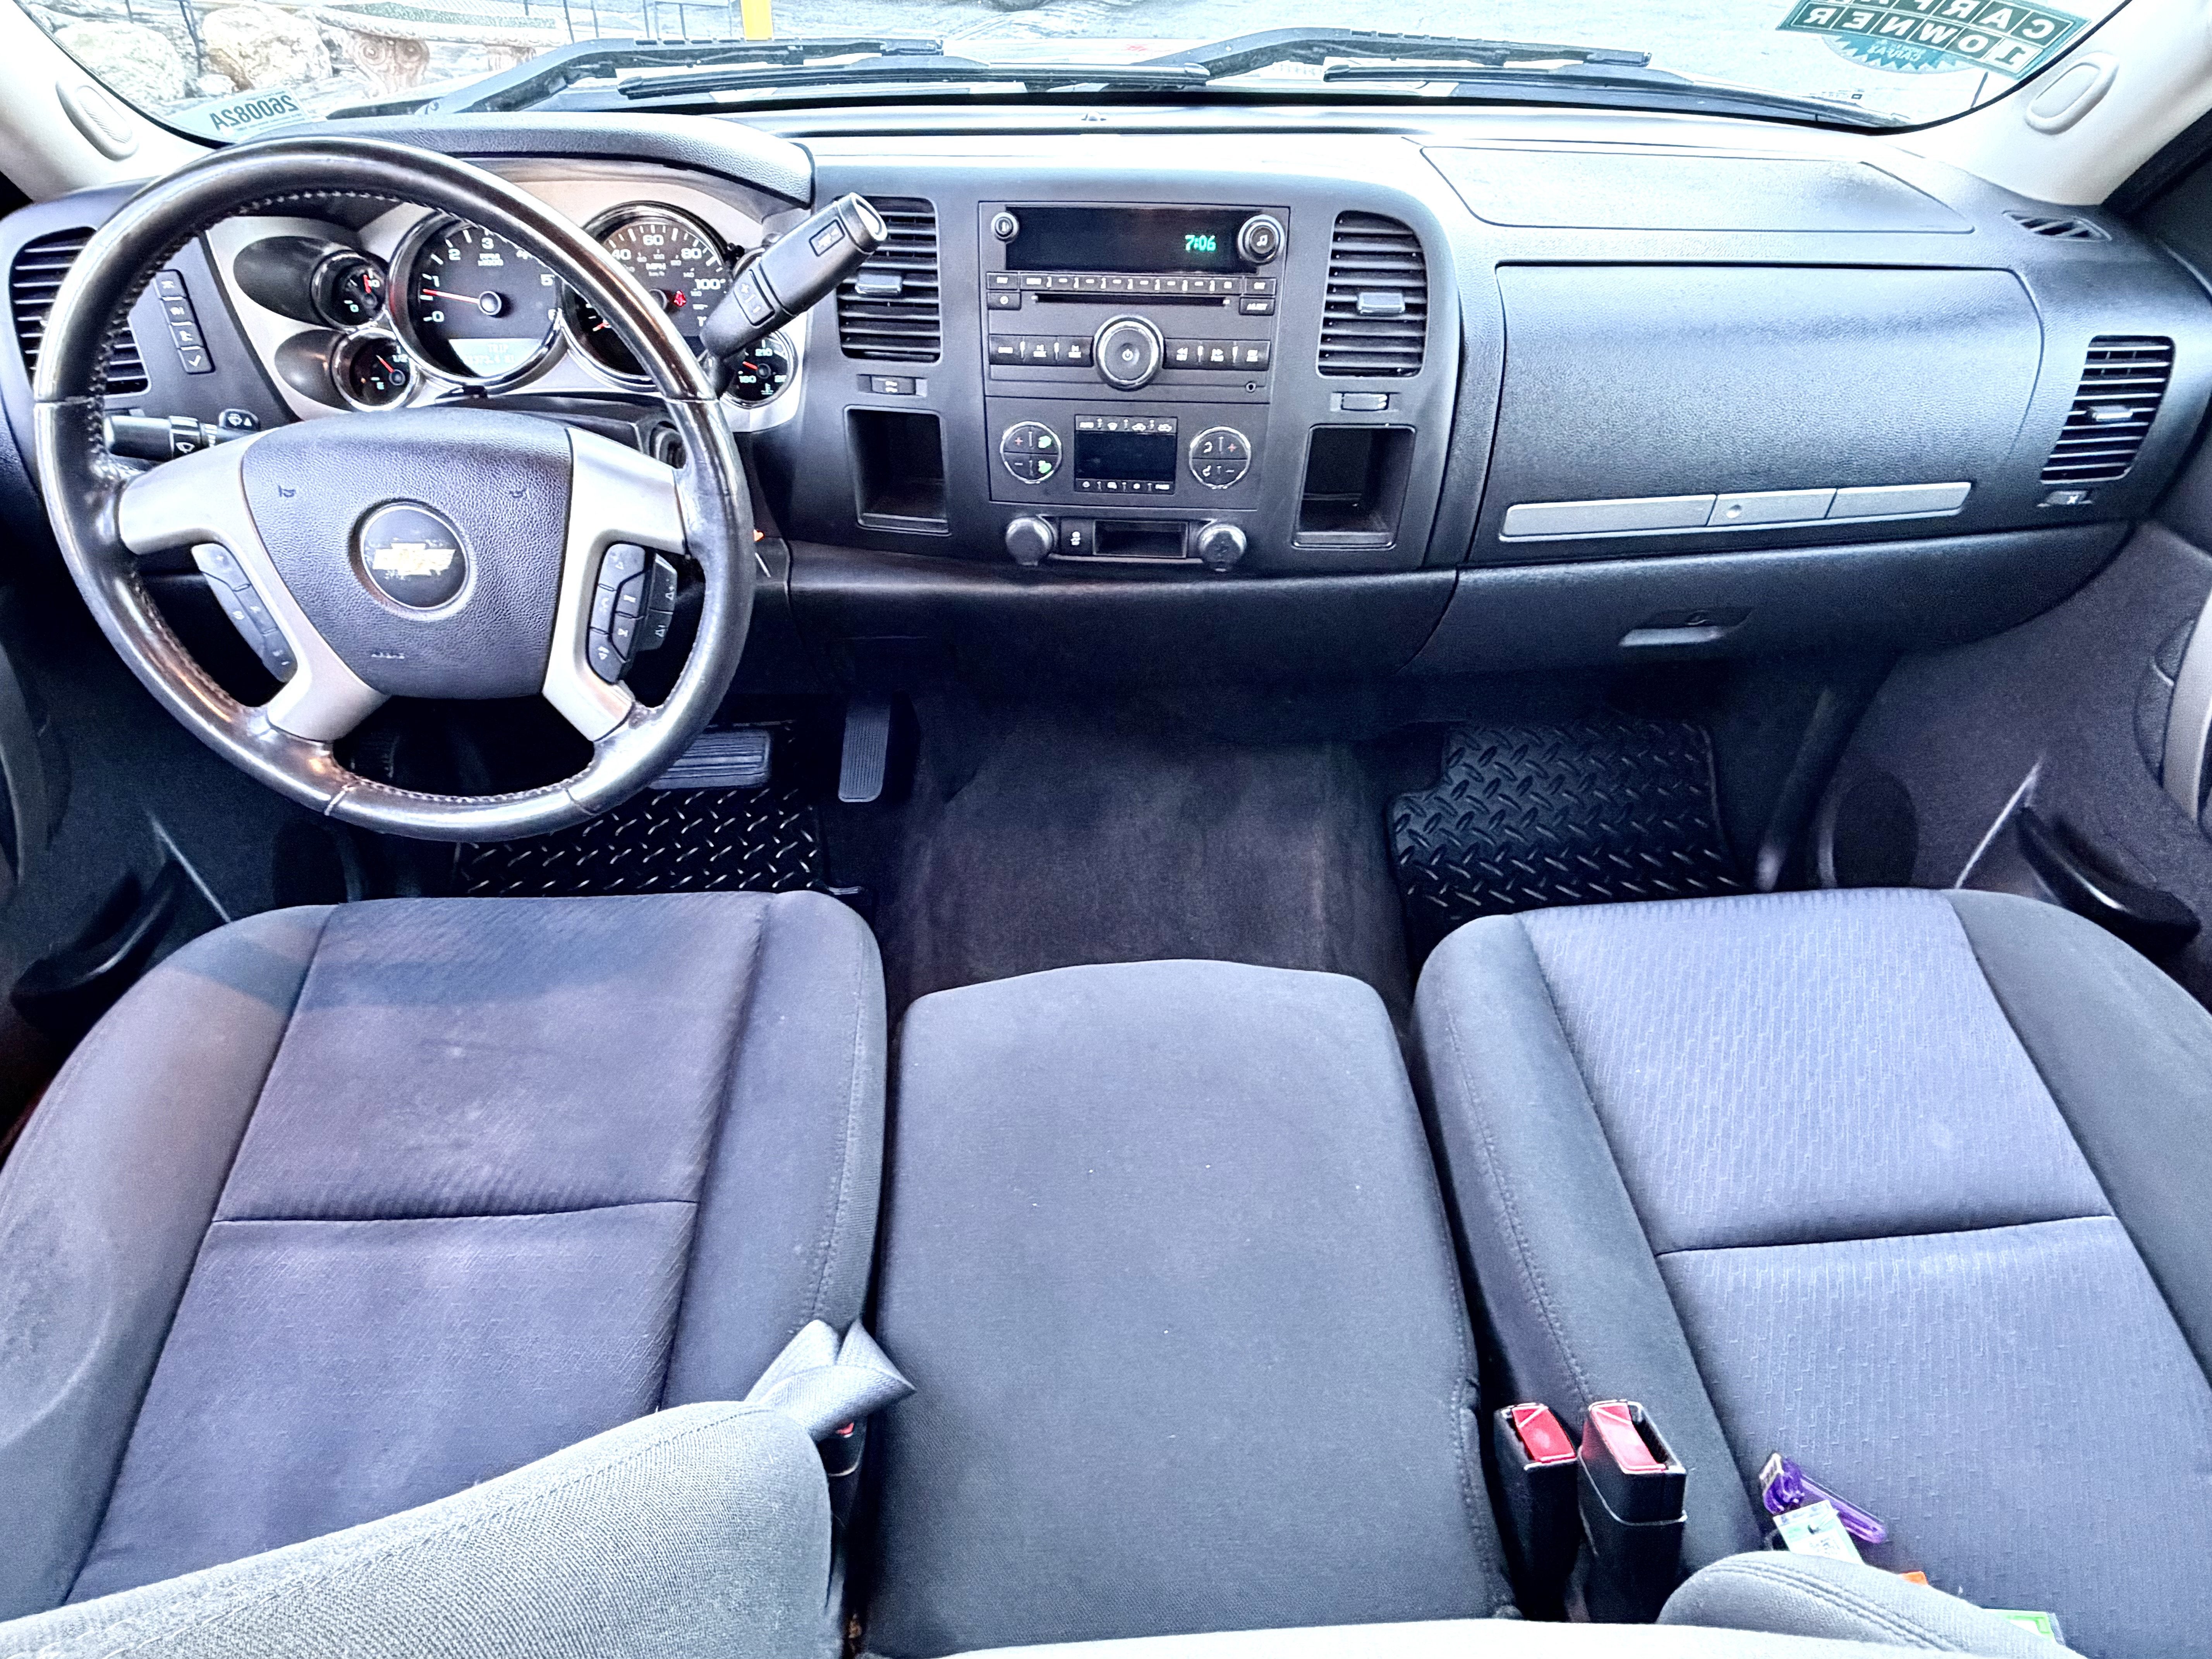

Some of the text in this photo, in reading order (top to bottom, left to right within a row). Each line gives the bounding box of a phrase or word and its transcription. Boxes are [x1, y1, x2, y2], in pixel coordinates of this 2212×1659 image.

[482, 237, 494, 249] 3
[643, 234, 664, 245] 60
[1185, 235, 1216, 251] 7:06
[448, 249, 460, 260] 2
[611, 249, 631, 260] 40
[681, 248, 702, 259] 80
[432, 275, 440, 287] 1
[541, 274, 555, 286] 5
[695, 278, 721, 290] 100
[432, 311, 444, 322] 0
